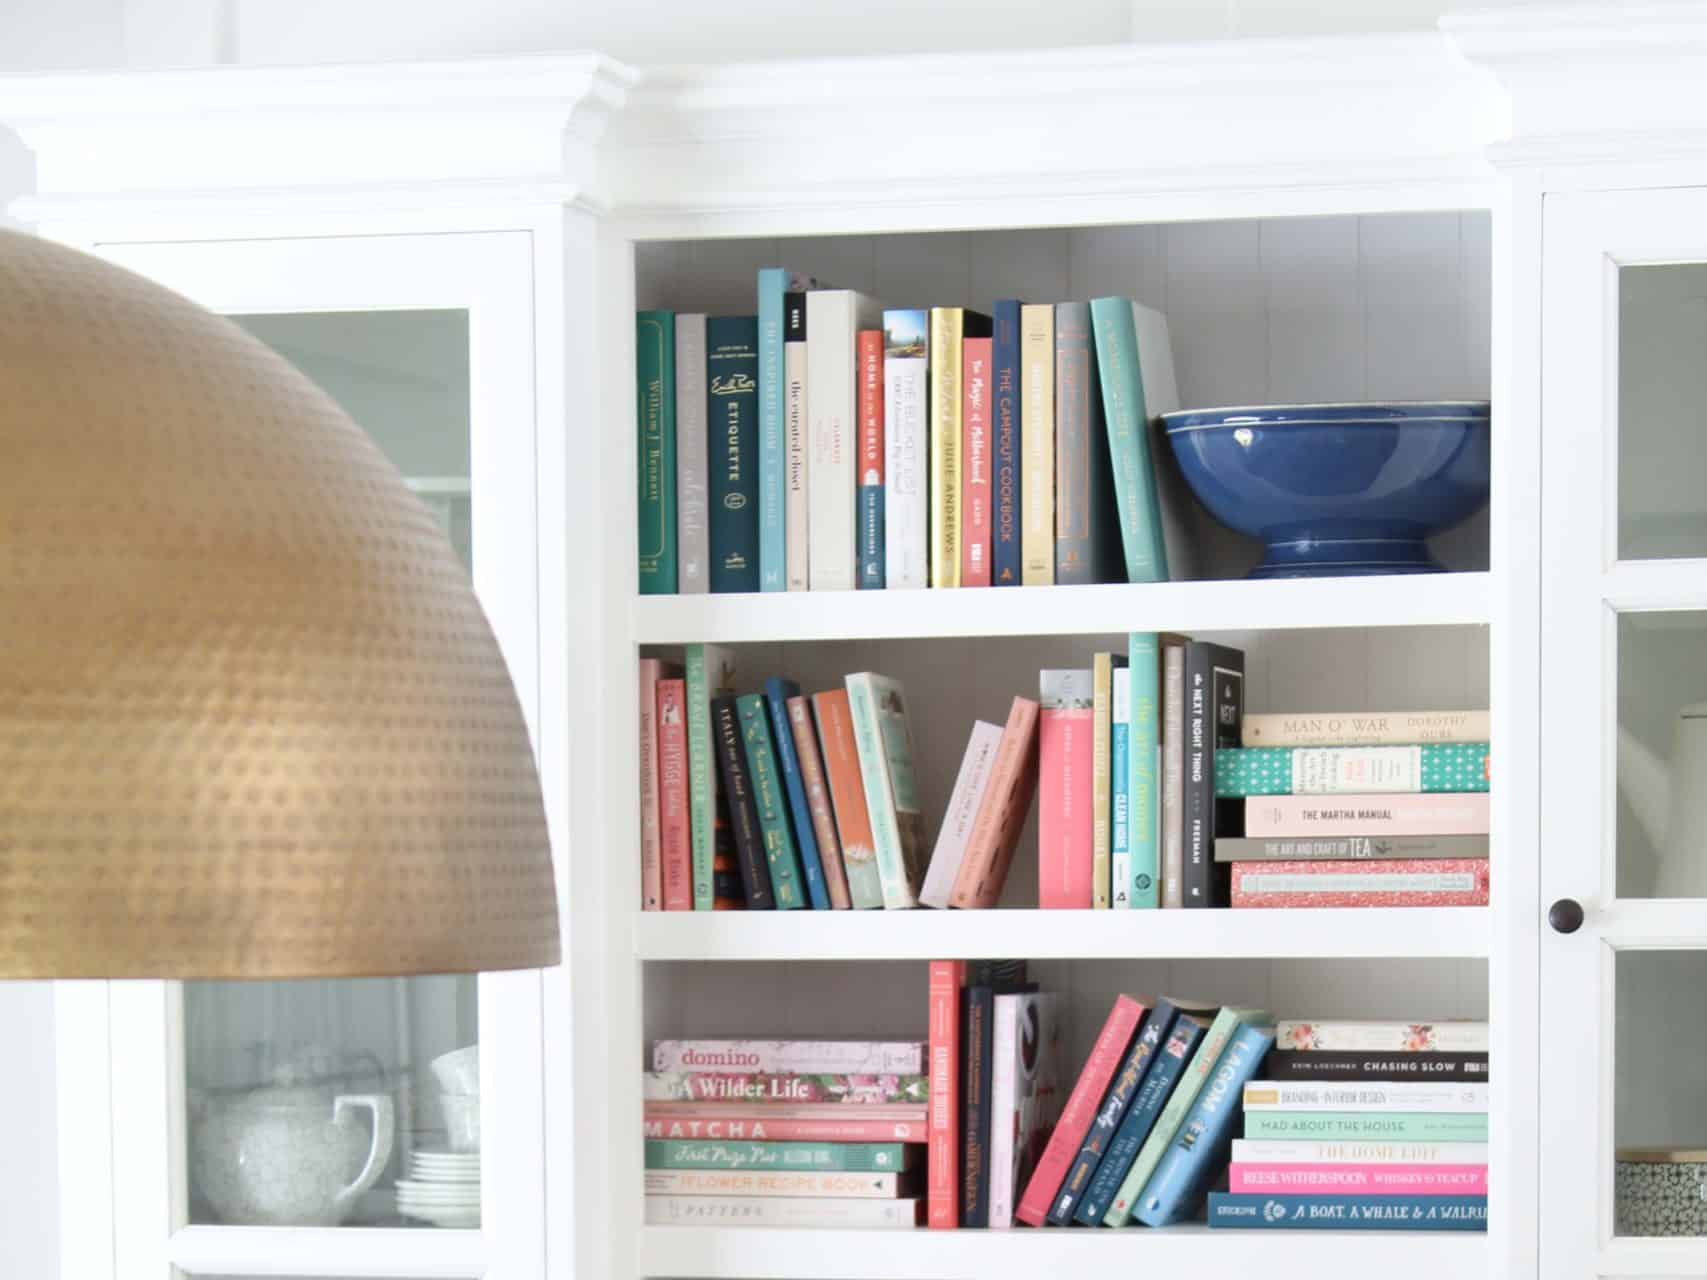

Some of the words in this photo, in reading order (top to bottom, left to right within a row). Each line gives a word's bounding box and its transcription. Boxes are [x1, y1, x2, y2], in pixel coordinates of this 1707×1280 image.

[866, 355, 876, 389] HOME
[999, 368, 1011, 392] THE
[647, 380, 661, 432] William
[791, 381, 801, 401] the
[728, 401, 739, 481] ETIQUETTE
[791, 403, 801, 453] curated
[866, 419, 877, 460] WORLD
[999, 397, 1012, 462] CAMPOUT
[791, 456, 801, 492] closet
[944, 440, 955, 480] JULIE
[944, 483, 955, 554] ANDREWS
[1000, 466, 1013, 542] COOKBOOK
[1192, 688, 1203, 714] NEXT
[719, 707, 736, 745] ITALY
[1192, 718, 1203, 749] RIGHT
[1284, 719, 1324, 733] MAN
[1353, 718, 1390, 732] WAR
[663, 743, 682, 786] HYGGE
[1192, 752, 1203, 783] THING
[1302, 810, 1318, 821] THE
[1320, 809, 1356, 821] MARTHA
[1358, 809, 1393, 821] MANUAL
[1192, 820, 1201, 864] FREEMAN
[1349, 837, 1371, 857] TEA
[681, 1047, 761, 1067] domino
[1363, 1062, 1418, 1072] CHASING
[1421, 1062, 1456, 1073] SLOW
[698, 1076, 766, 1098] Wilder
[771, 1076, 809, 1098] Life
[1203, 1041, 1249, 1113] LAGOM
[644, 1120, 769, 1139] MATCHA
[1261, 1119, 1287, 1132] MAD
[1290, 1119, 1333, 1132] ABOUT
[1335, 1119, 1360, 1132] THE
[1363, 1119, 1407, 1132] HOUSE
[1349, 1205, 1360, 1218] A
[1362, 1205, 1409, 1219] WHALE
[1425, 1206, 1437, 1219] A
